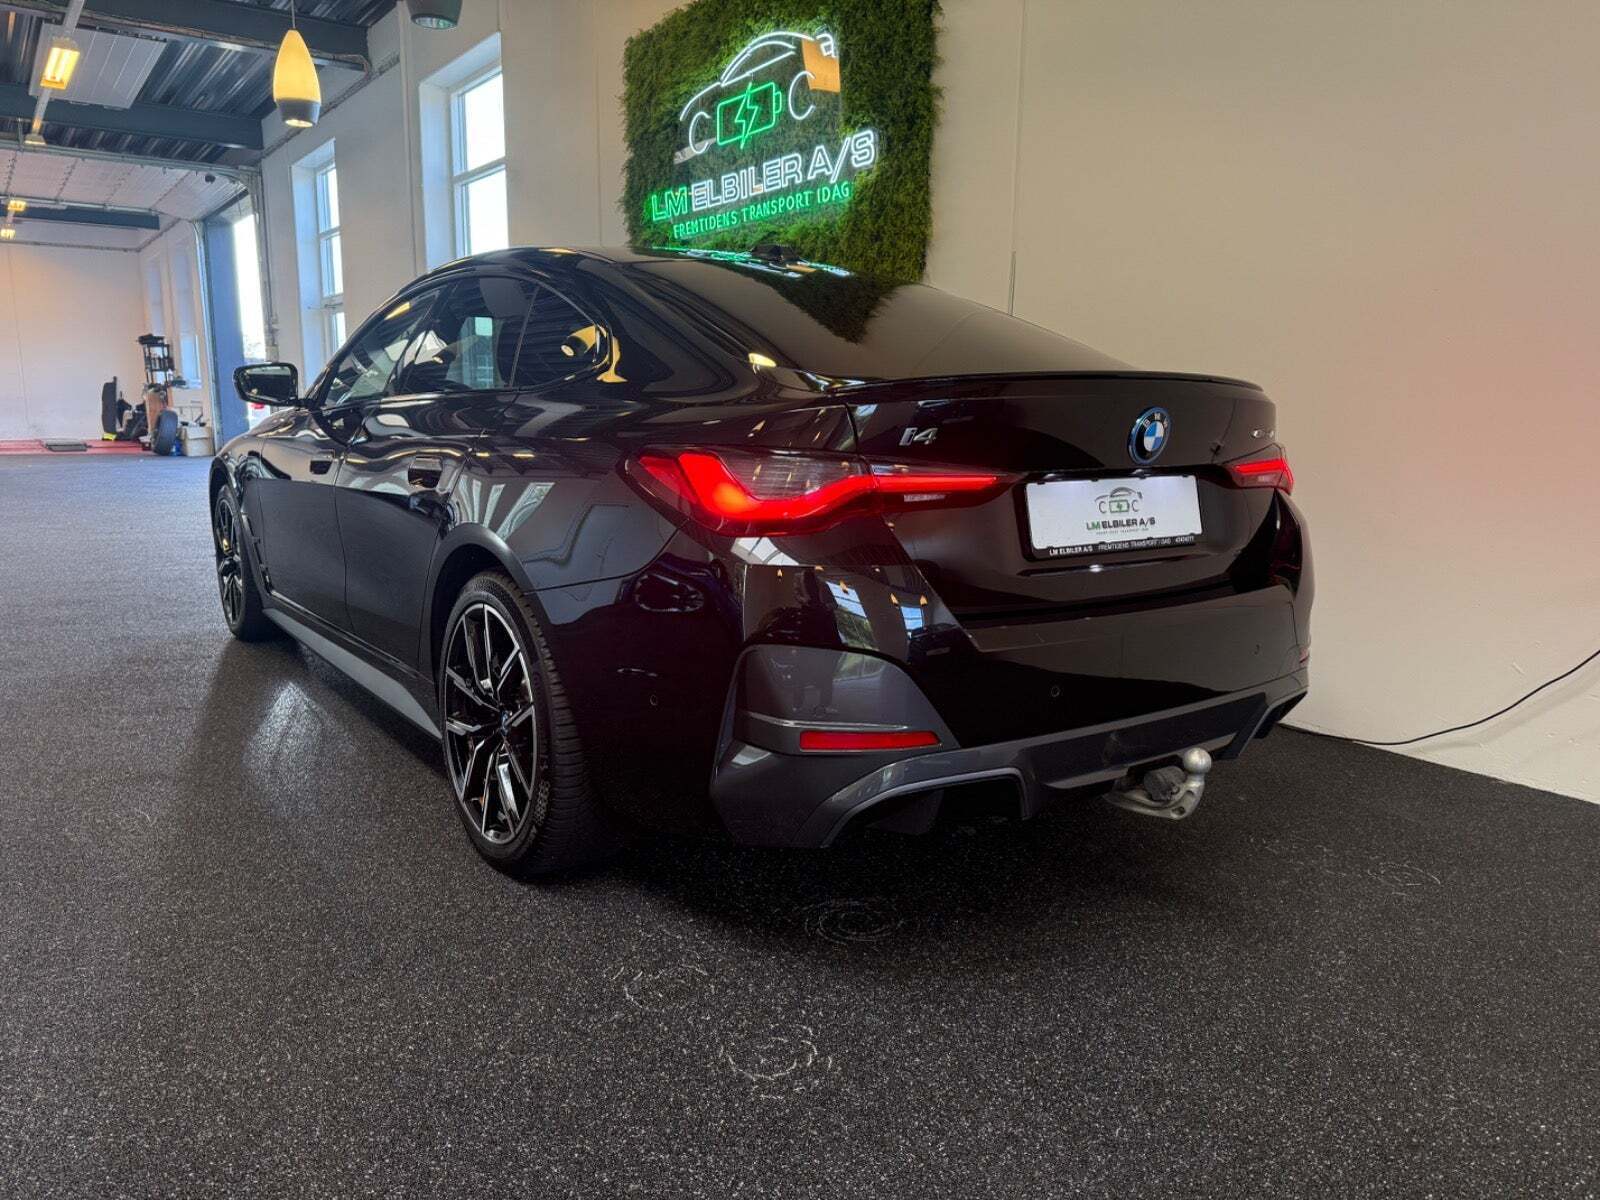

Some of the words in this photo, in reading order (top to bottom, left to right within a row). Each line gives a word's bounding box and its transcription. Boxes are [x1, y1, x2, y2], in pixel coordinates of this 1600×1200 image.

[652, 187, 688, 220] LM
[691, 153, 803, 212] ELBILER
[807, 130, 875, 184] A/S
[673, 211, 737, 239] FREMTIDENS
[741, 190, 814, 222] TRANSPORT
[899, 427, 938, 446] i4
[1086, 520, 1101, 531] LM
[1101, 518, 1138, 529] ELBILER
[1139, 516, 1156, 527] A/S
